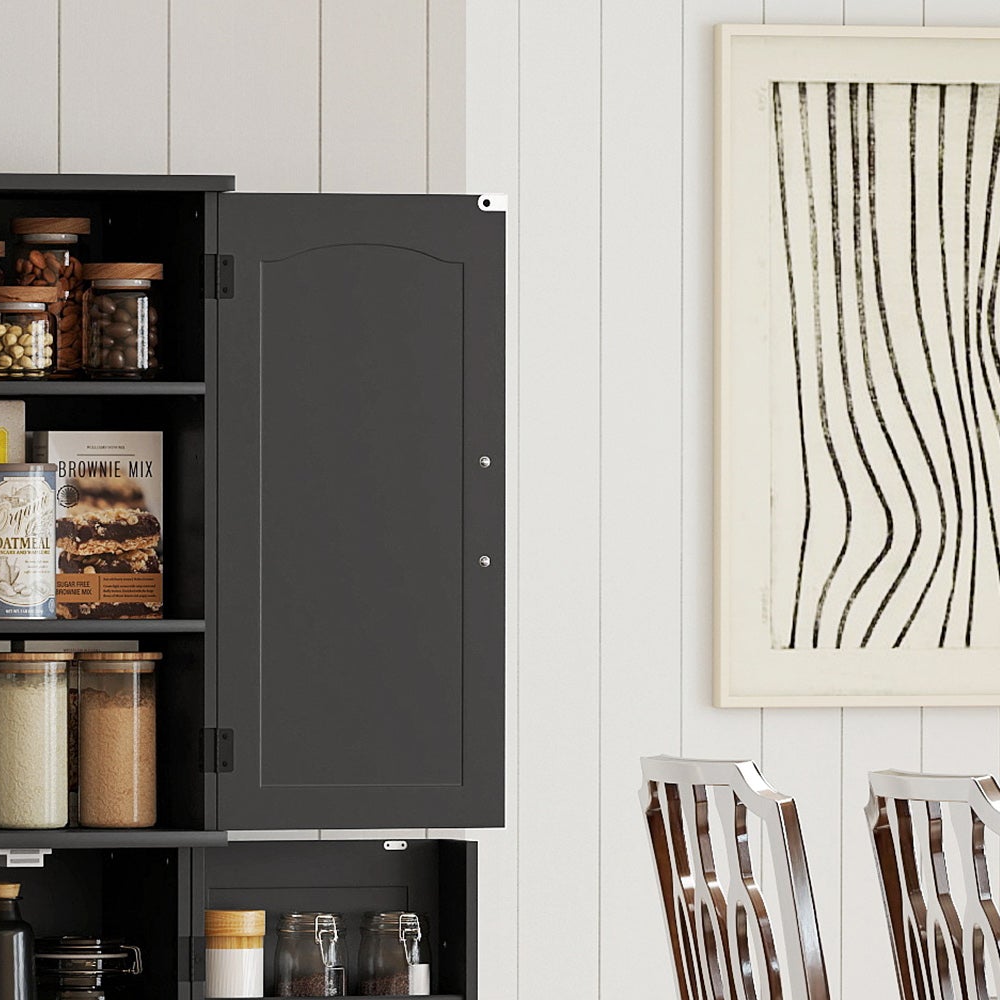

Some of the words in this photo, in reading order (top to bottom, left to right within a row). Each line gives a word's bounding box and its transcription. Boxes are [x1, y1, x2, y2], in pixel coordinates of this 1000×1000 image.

[58, 461, 121, 478] BROWNIE
[129, 461, 153, 478] MIX
[82, 588, 93, 596] MIX
